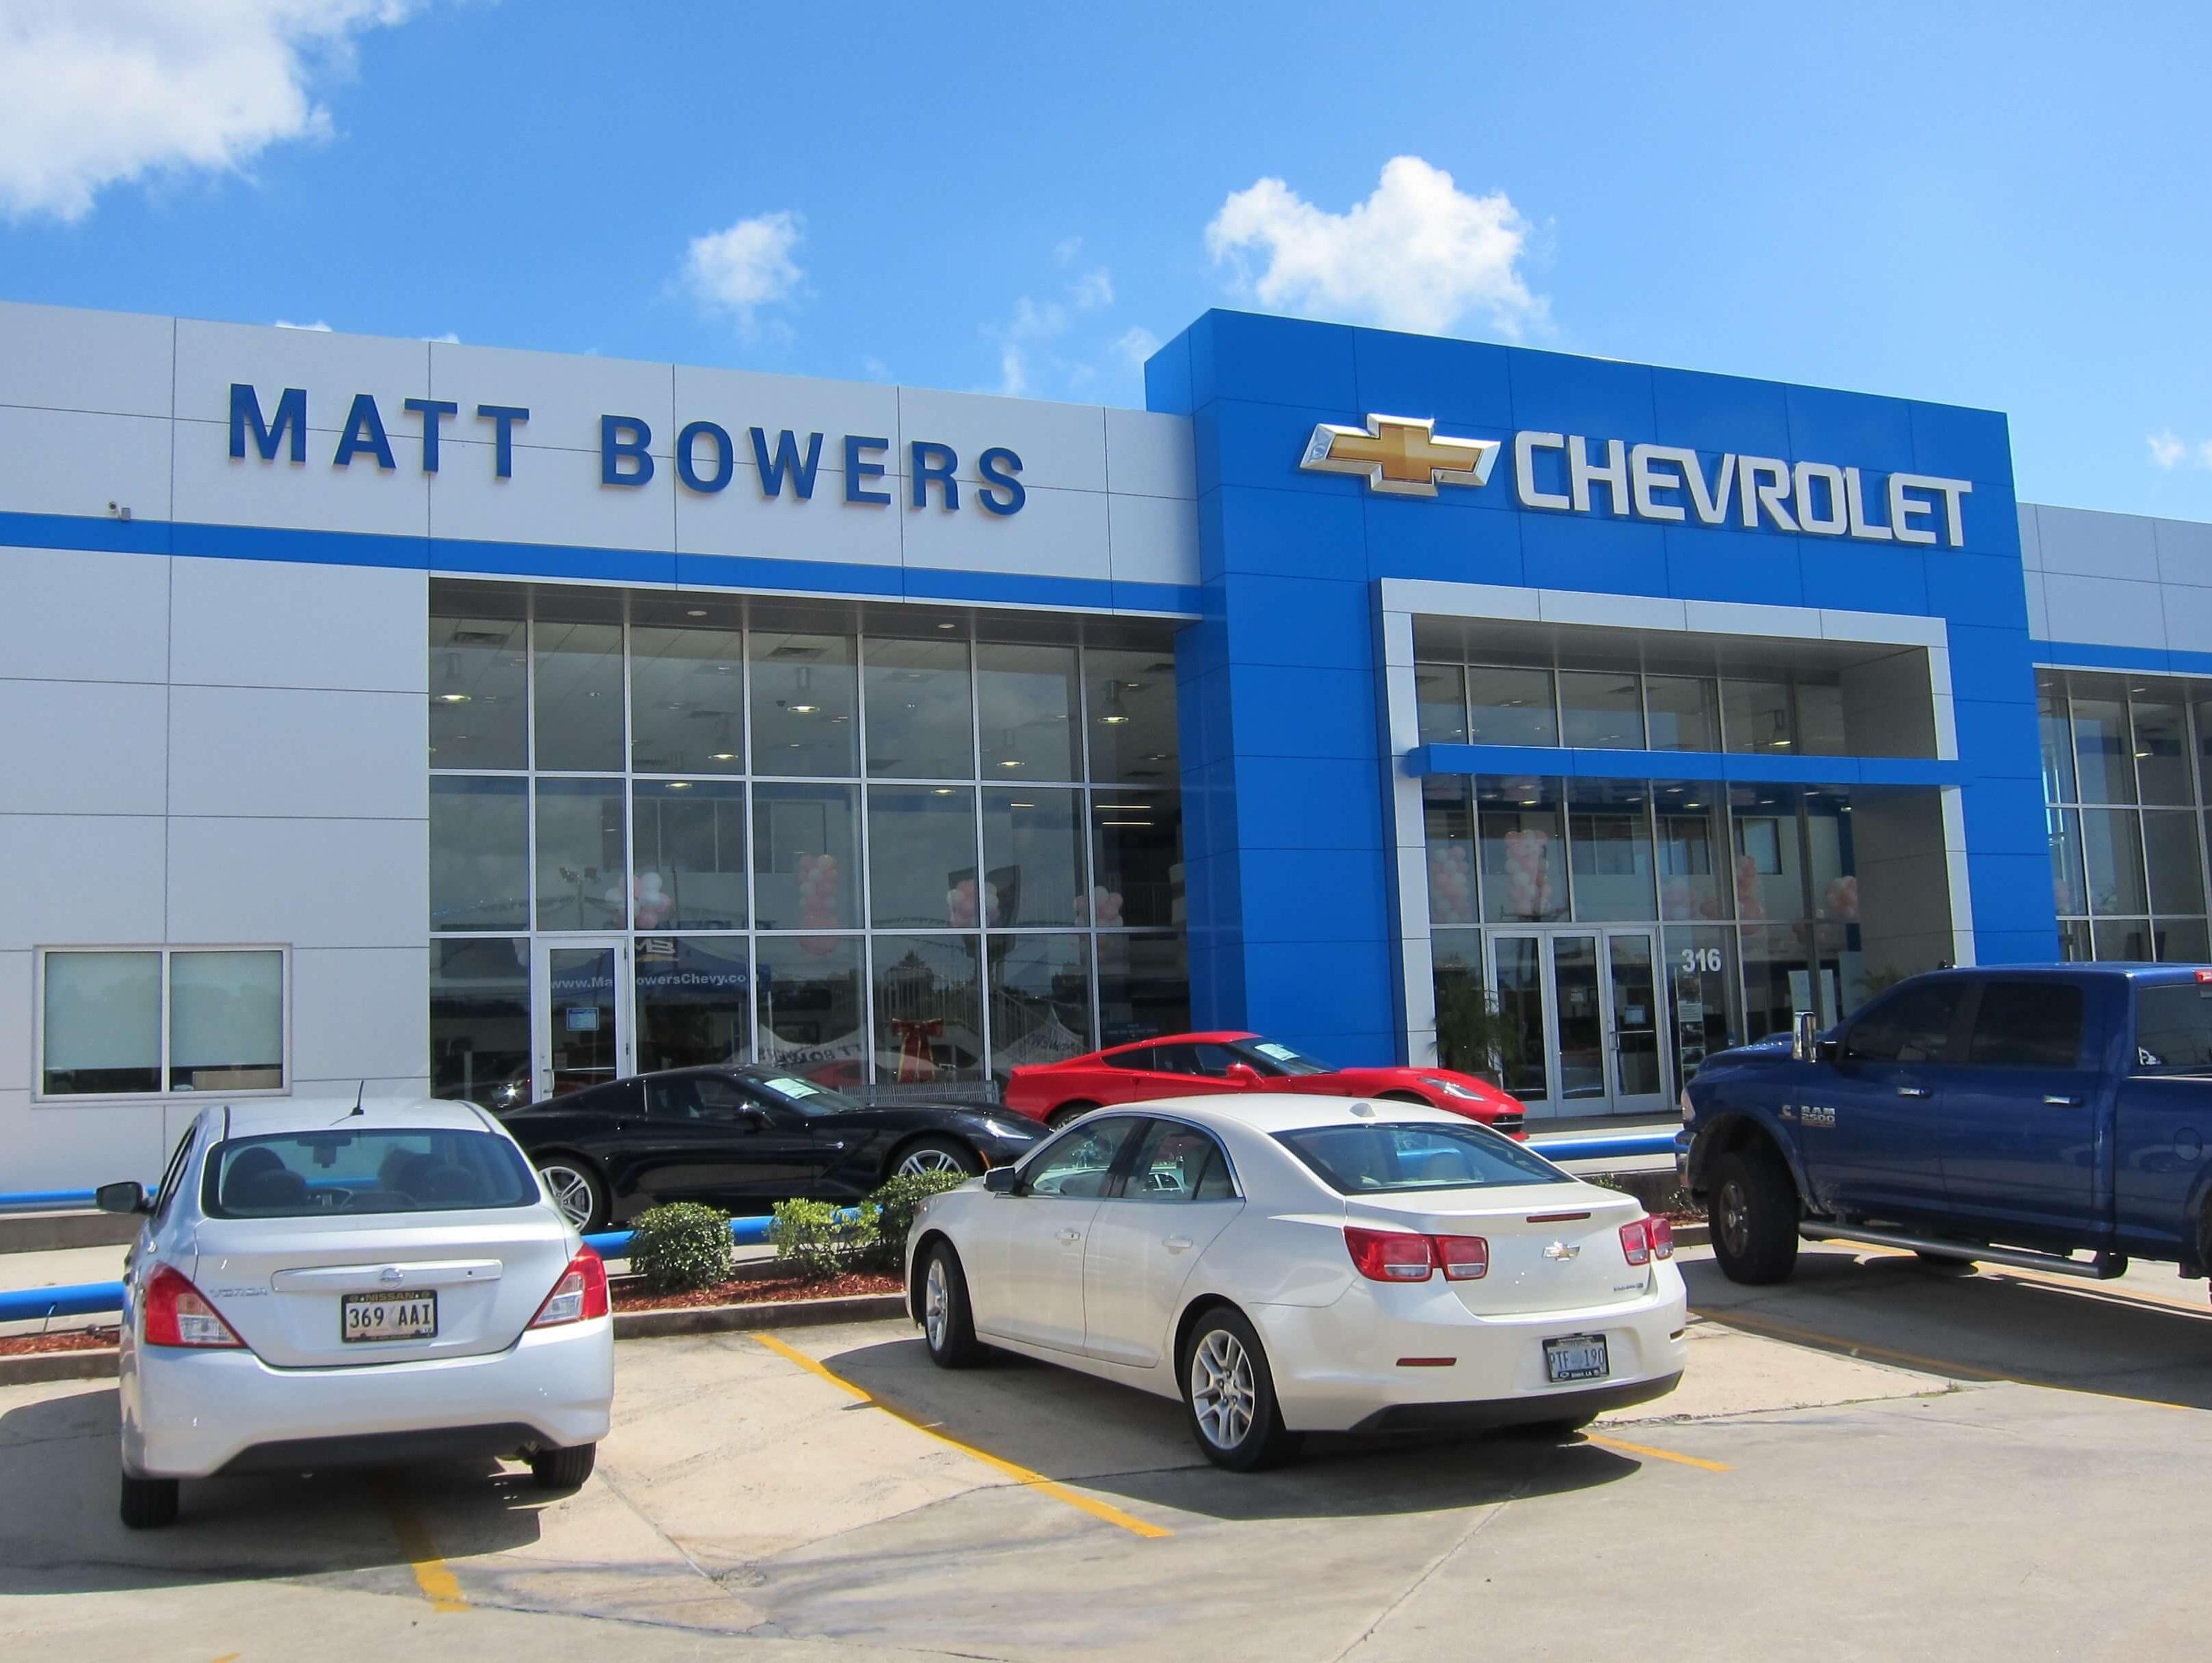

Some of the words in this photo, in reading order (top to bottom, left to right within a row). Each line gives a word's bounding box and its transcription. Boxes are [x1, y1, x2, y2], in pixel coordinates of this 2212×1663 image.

[228, 382, 530, 480] MATT
[600, 413, 1027, 517] BOWERS
[1513, 430, 1973, 548] CHEVROLET
[1681, 948, 1722, 972] 316
[551, 974, 759, 989] www.MaowersChevy.co
[1800, 1106, 1835, 1115] RAM
[1800, 1113, 1835, 1123] 2500
[365, 1292, 416, 1302] NISSAN
[349, 1307, 384, 1329] 369
[398, 1304, 431, 1327] AAI
